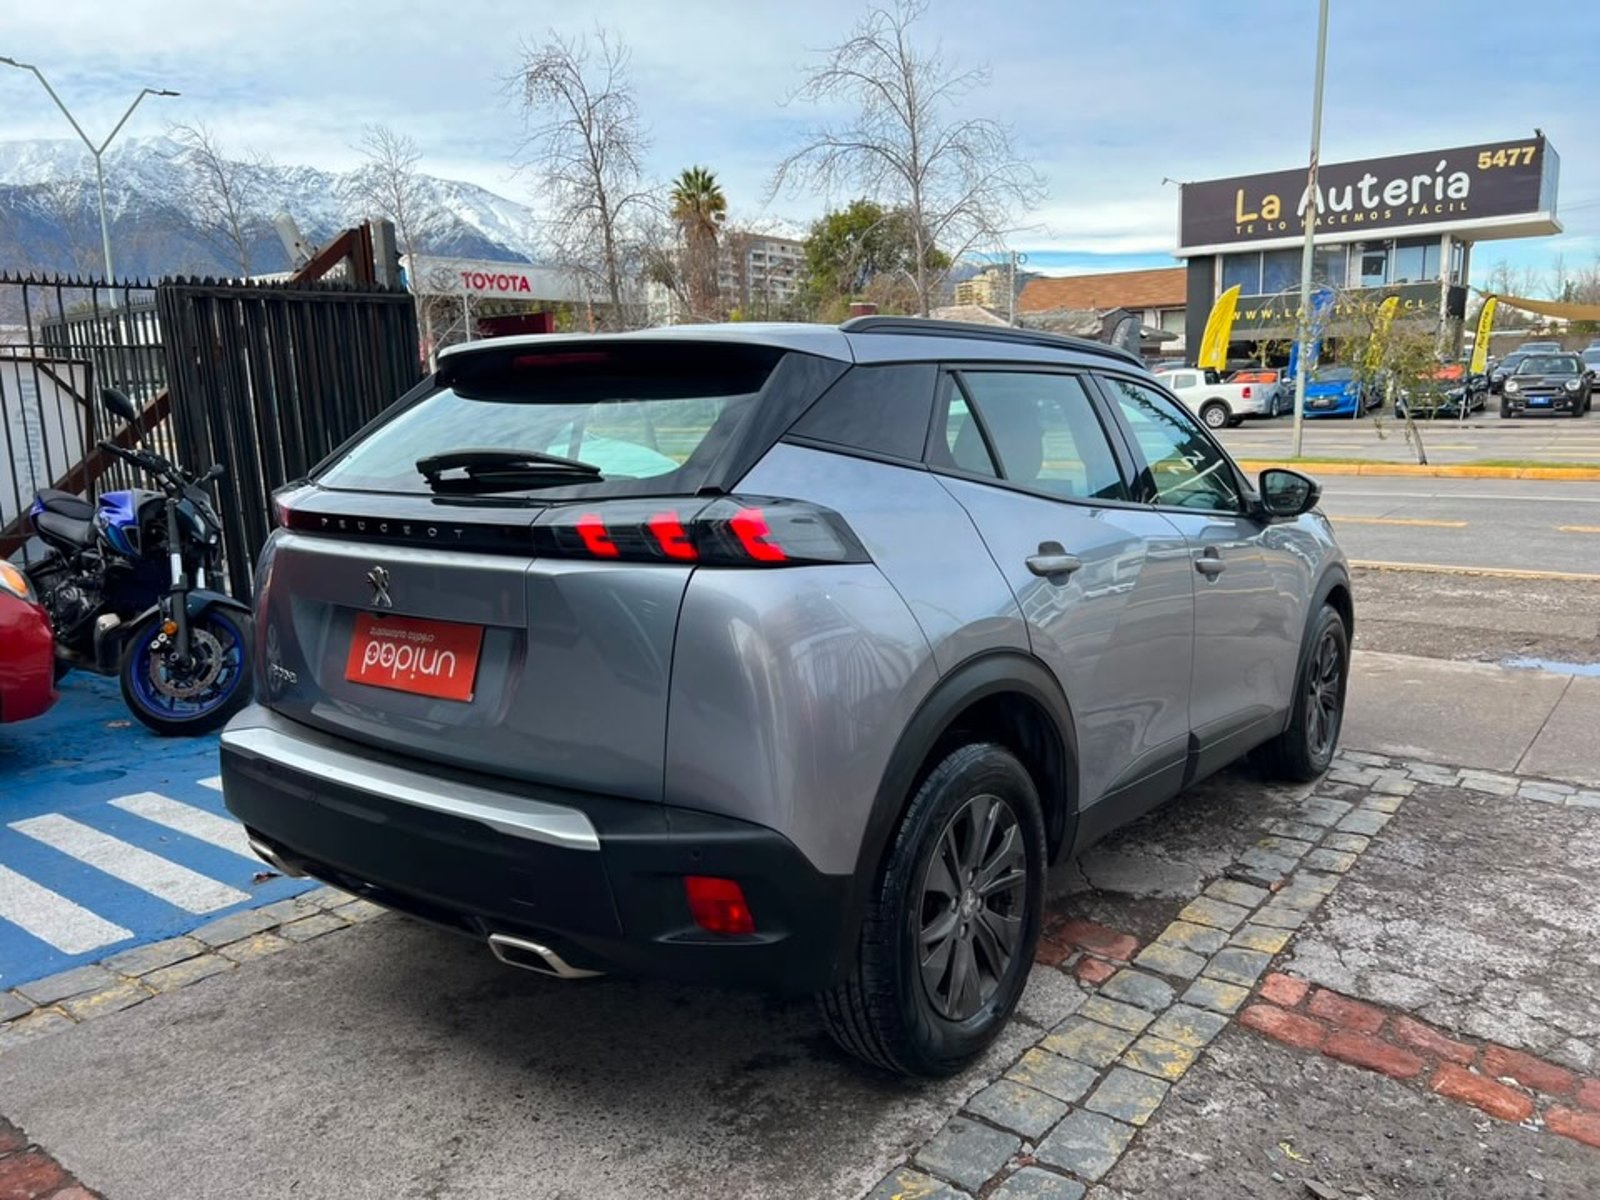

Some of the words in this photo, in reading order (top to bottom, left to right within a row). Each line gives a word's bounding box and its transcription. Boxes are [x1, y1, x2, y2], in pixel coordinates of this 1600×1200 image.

[1477, 146, 1536, 170] 5477
[1236, 188, 1281, 224] La
[1297, 160, 1470, 217] Autería
[1236, 225, 1253, 235] TE
[1267, 221, 1287, 231] LO
[1301, 209, 1391, 228] HACEMOS
[1408, 202, 1467, 217] FÁCIL
[460, 272, 531, 293] TOYOTA
[320, 517, 463, 539] PEUGEOT
[361, 641, 456, 680] unidad
